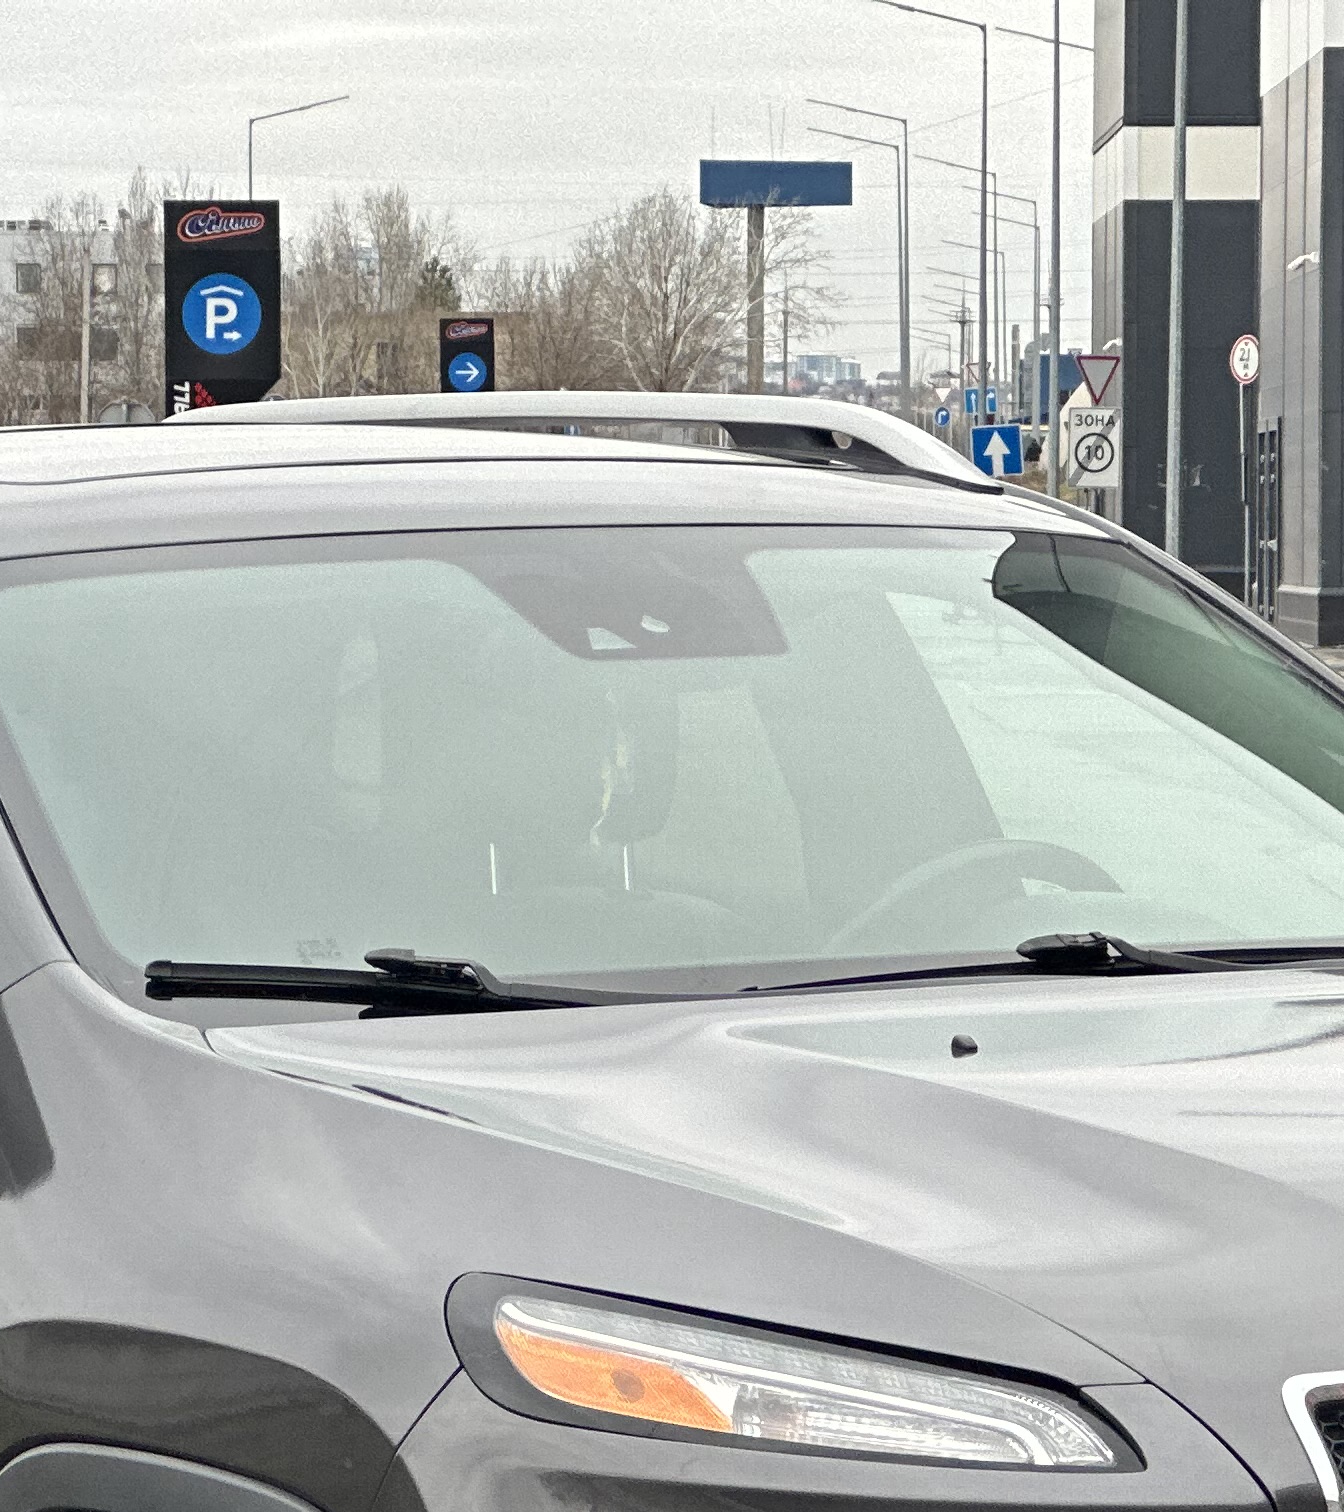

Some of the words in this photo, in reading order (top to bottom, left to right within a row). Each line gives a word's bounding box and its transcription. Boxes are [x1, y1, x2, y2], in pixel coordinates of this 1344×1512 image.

[206, 298, 238, 338] P
[1074, 413, 1116, 427] ЗОНА
[1085, 444, 1104, 461] 10
